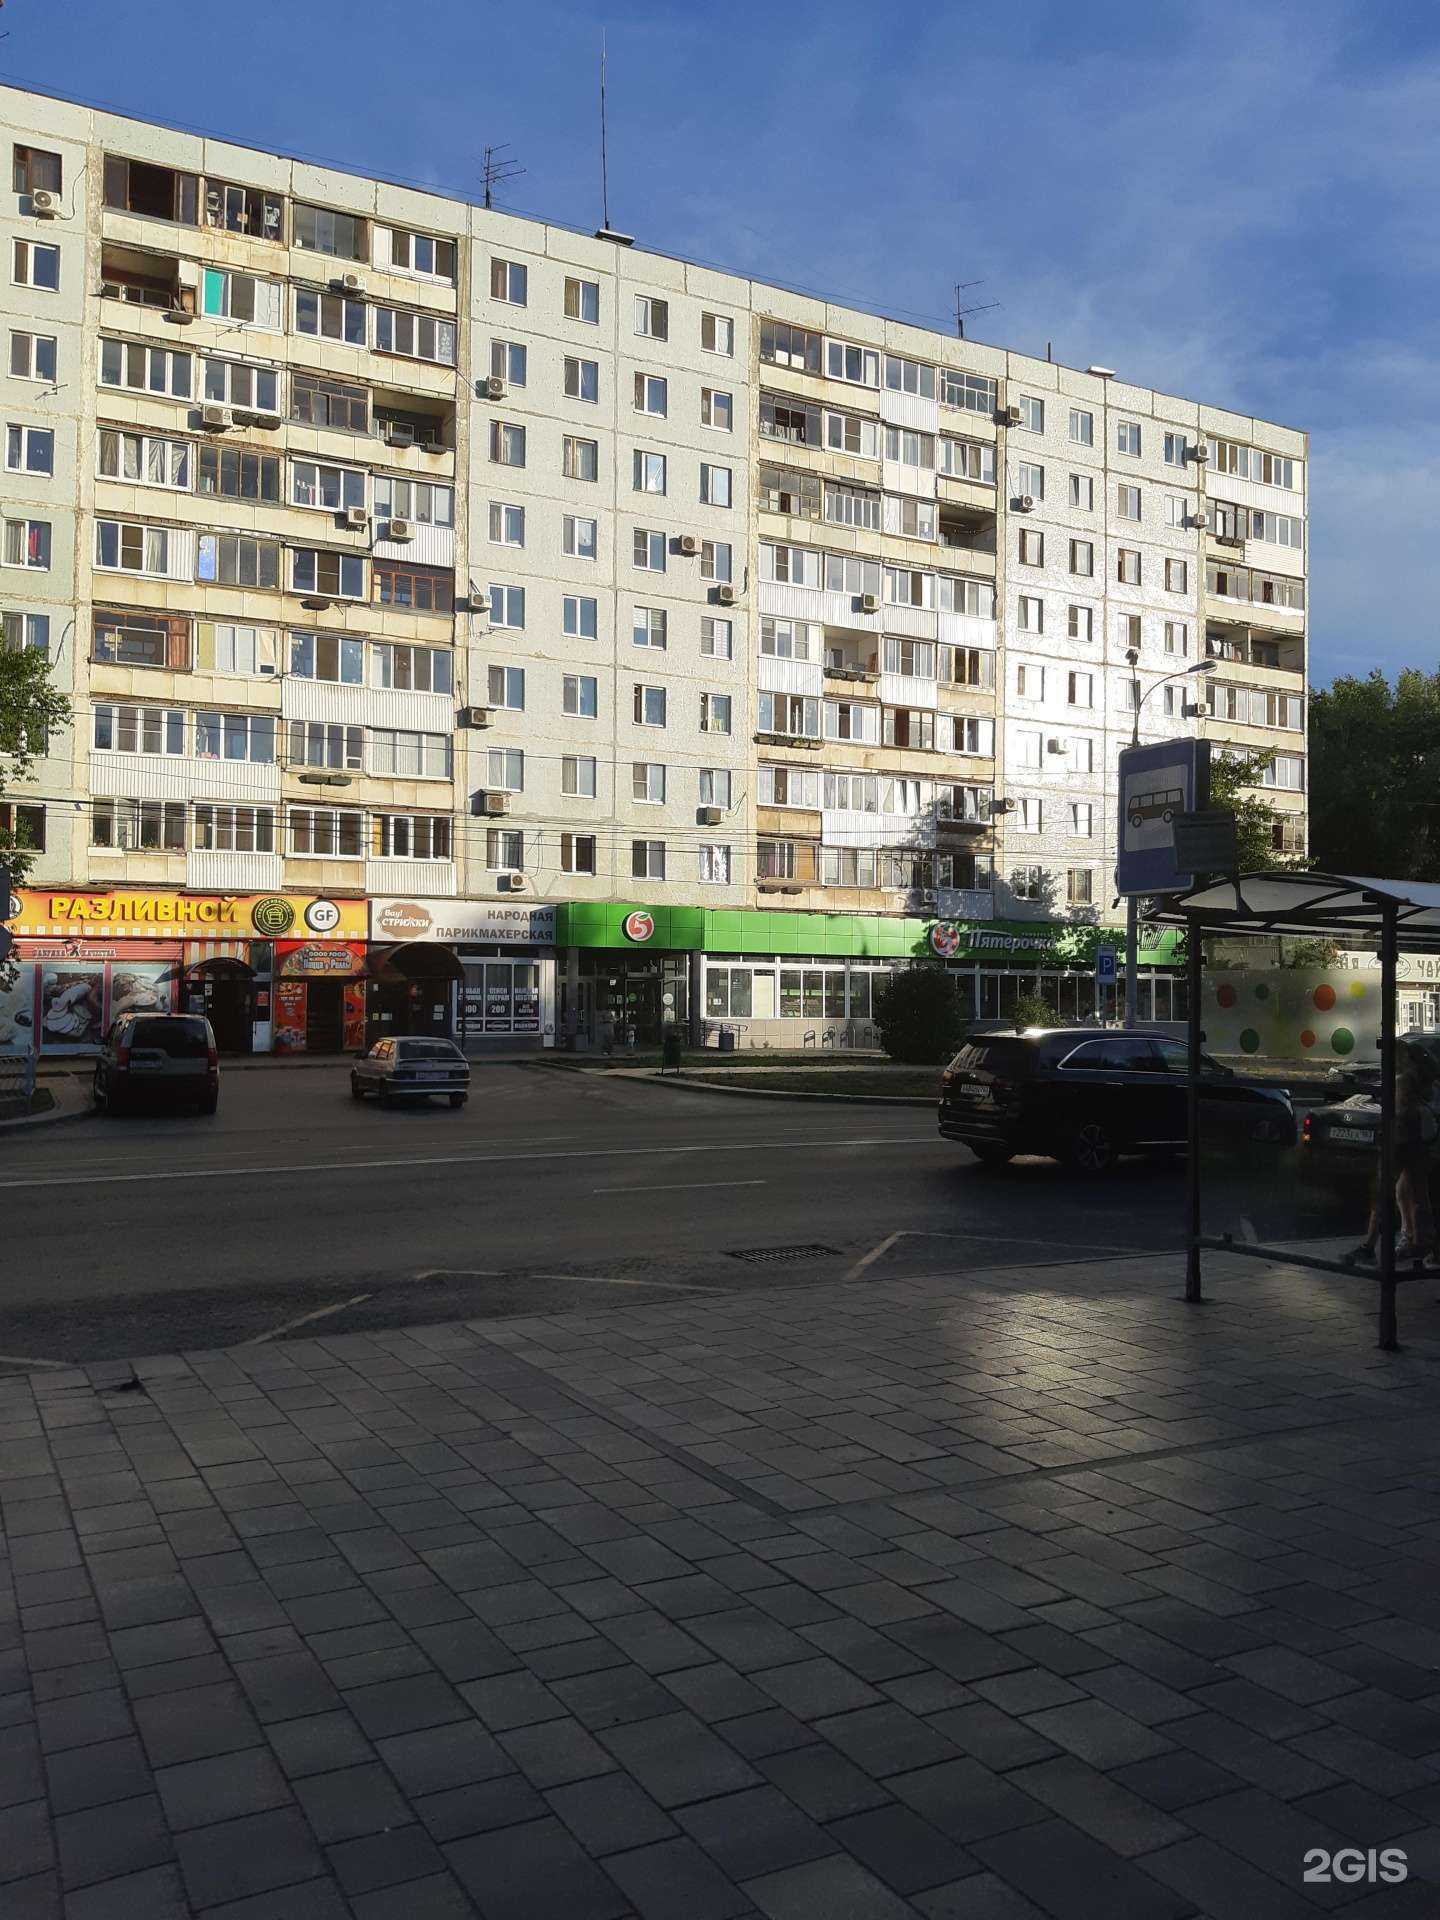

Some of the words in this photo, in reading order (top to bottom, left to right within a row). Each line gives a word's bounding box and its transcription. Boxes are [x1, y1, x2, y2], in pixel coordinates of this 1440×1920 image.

[49, 896, 240, 923] РАЗЛИВНОЙ
[314, 909, 334, 922] GF
[487, 910, 553, 922] НАРОДНАЯ
[436, 927, 553, 940] ПАРИКМАХЕРСКАЯ
[1103, 957, 1113, 973] P
